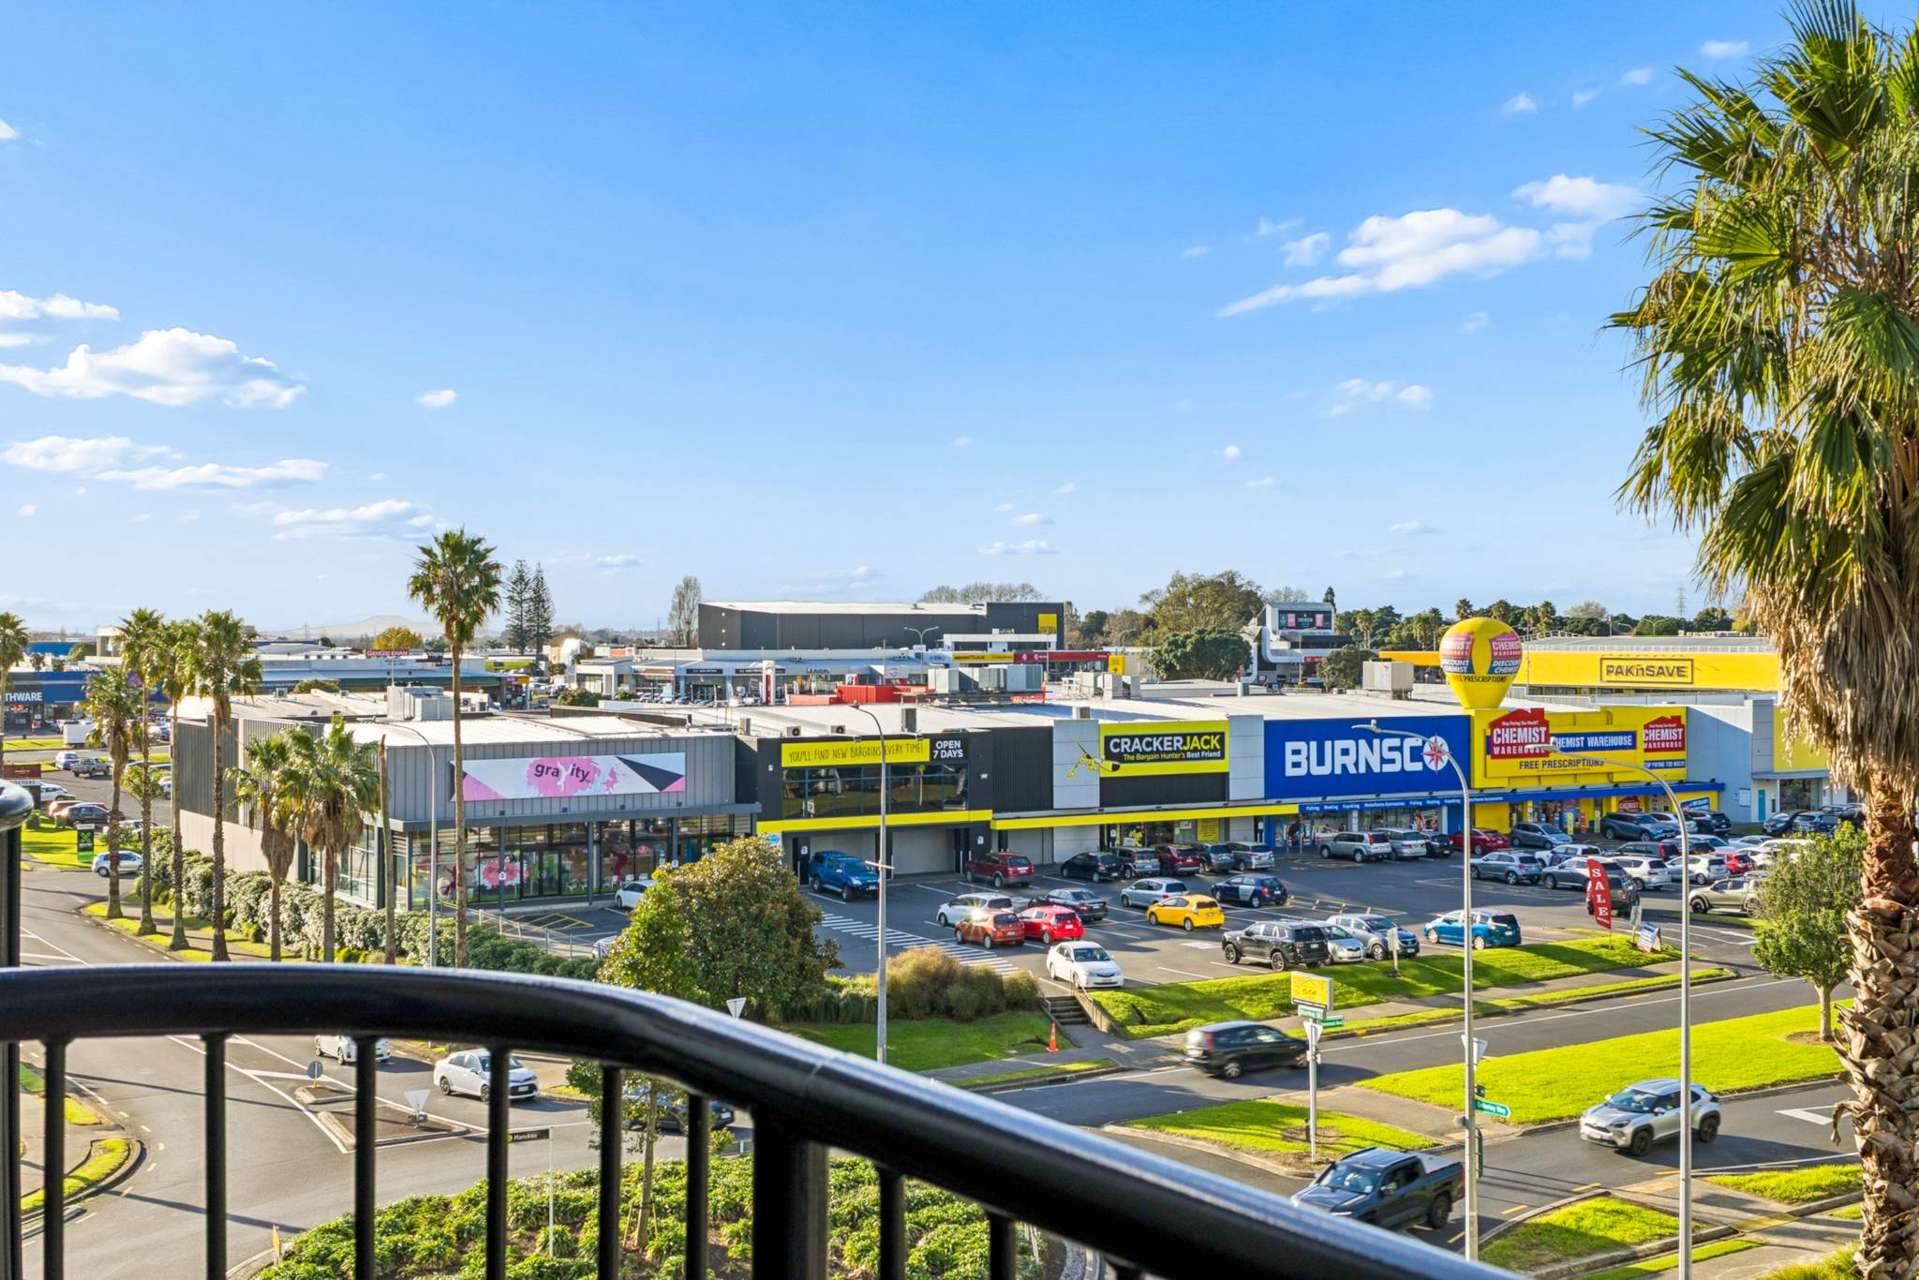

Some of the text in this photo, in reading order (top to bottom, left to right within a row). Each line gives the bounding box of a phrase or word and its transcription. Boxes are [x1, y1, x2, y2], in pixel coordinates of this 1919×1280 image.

[5, 691, 43, 702] THWARE
[1494, 726, 1546, 744] CHEMIST
[1644, 728, 1683, 741] CHEMIST
[935, 740, 961, 750] OPEN
[1109, 735, 1221, 752] CRACKERJACK
[1550, 735, 1632, 748] HEMIST WAREHOUSE
[814, 748, 830, 760] FIND
[833, 746, 848, 760] NEW
[933, 749, 964, 759] 7 DAYS
[1136, 753, 1159, 761] Bargain
[1201, 750, 1221, 758] Friend
[1494, 744, 1546, 755] WAREHOUSE
[1520, 758, 1604, 769] FREE PRESCRIPTIONS
[1592, 868, 1609, 916] SALE
